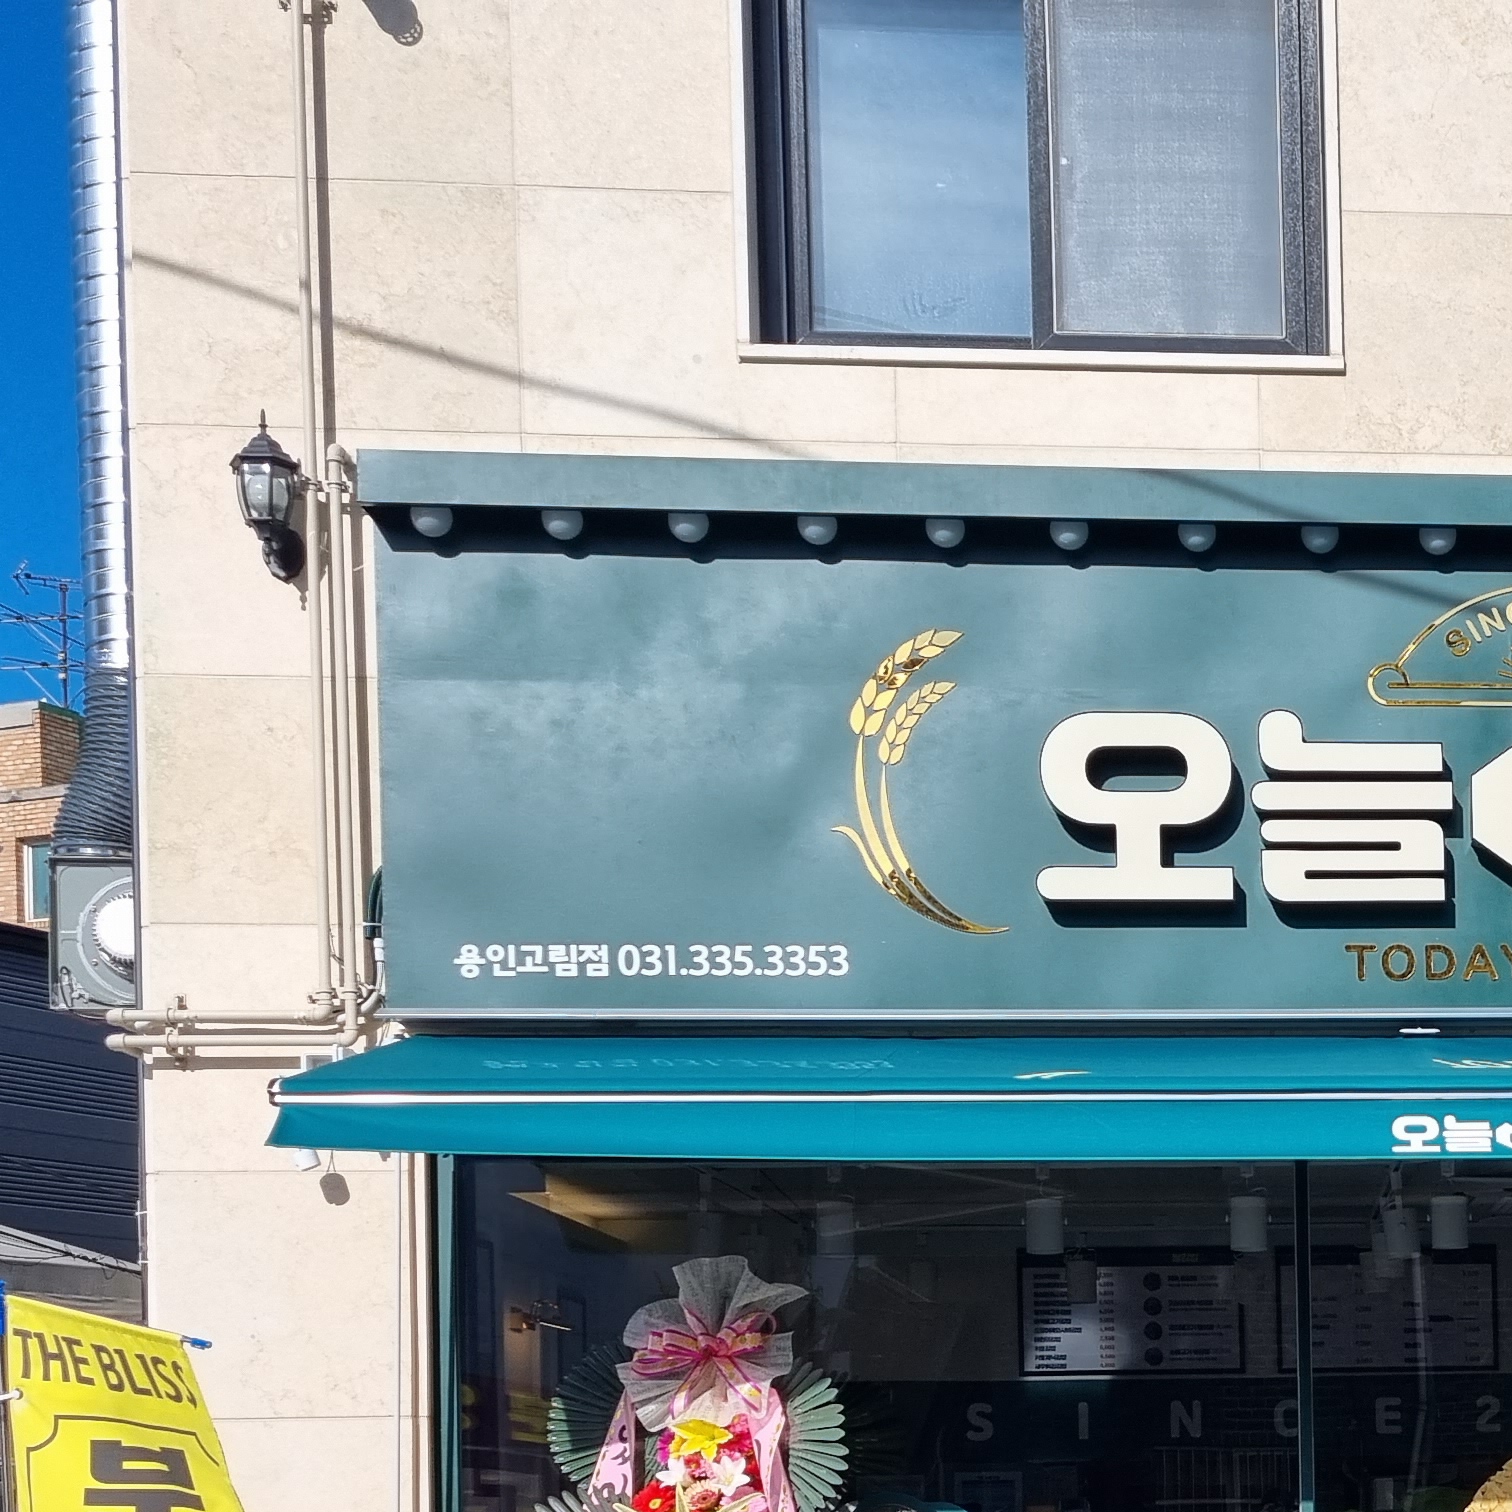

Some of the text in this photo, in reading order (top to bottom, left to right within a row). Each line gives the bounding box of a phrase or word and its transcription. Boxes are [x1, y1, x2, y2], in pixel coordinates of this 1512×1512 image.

[453, 943, 850, 978] 용인고림점 031.335.3353
[12, 1327, 198, 1409] THE BLISS
